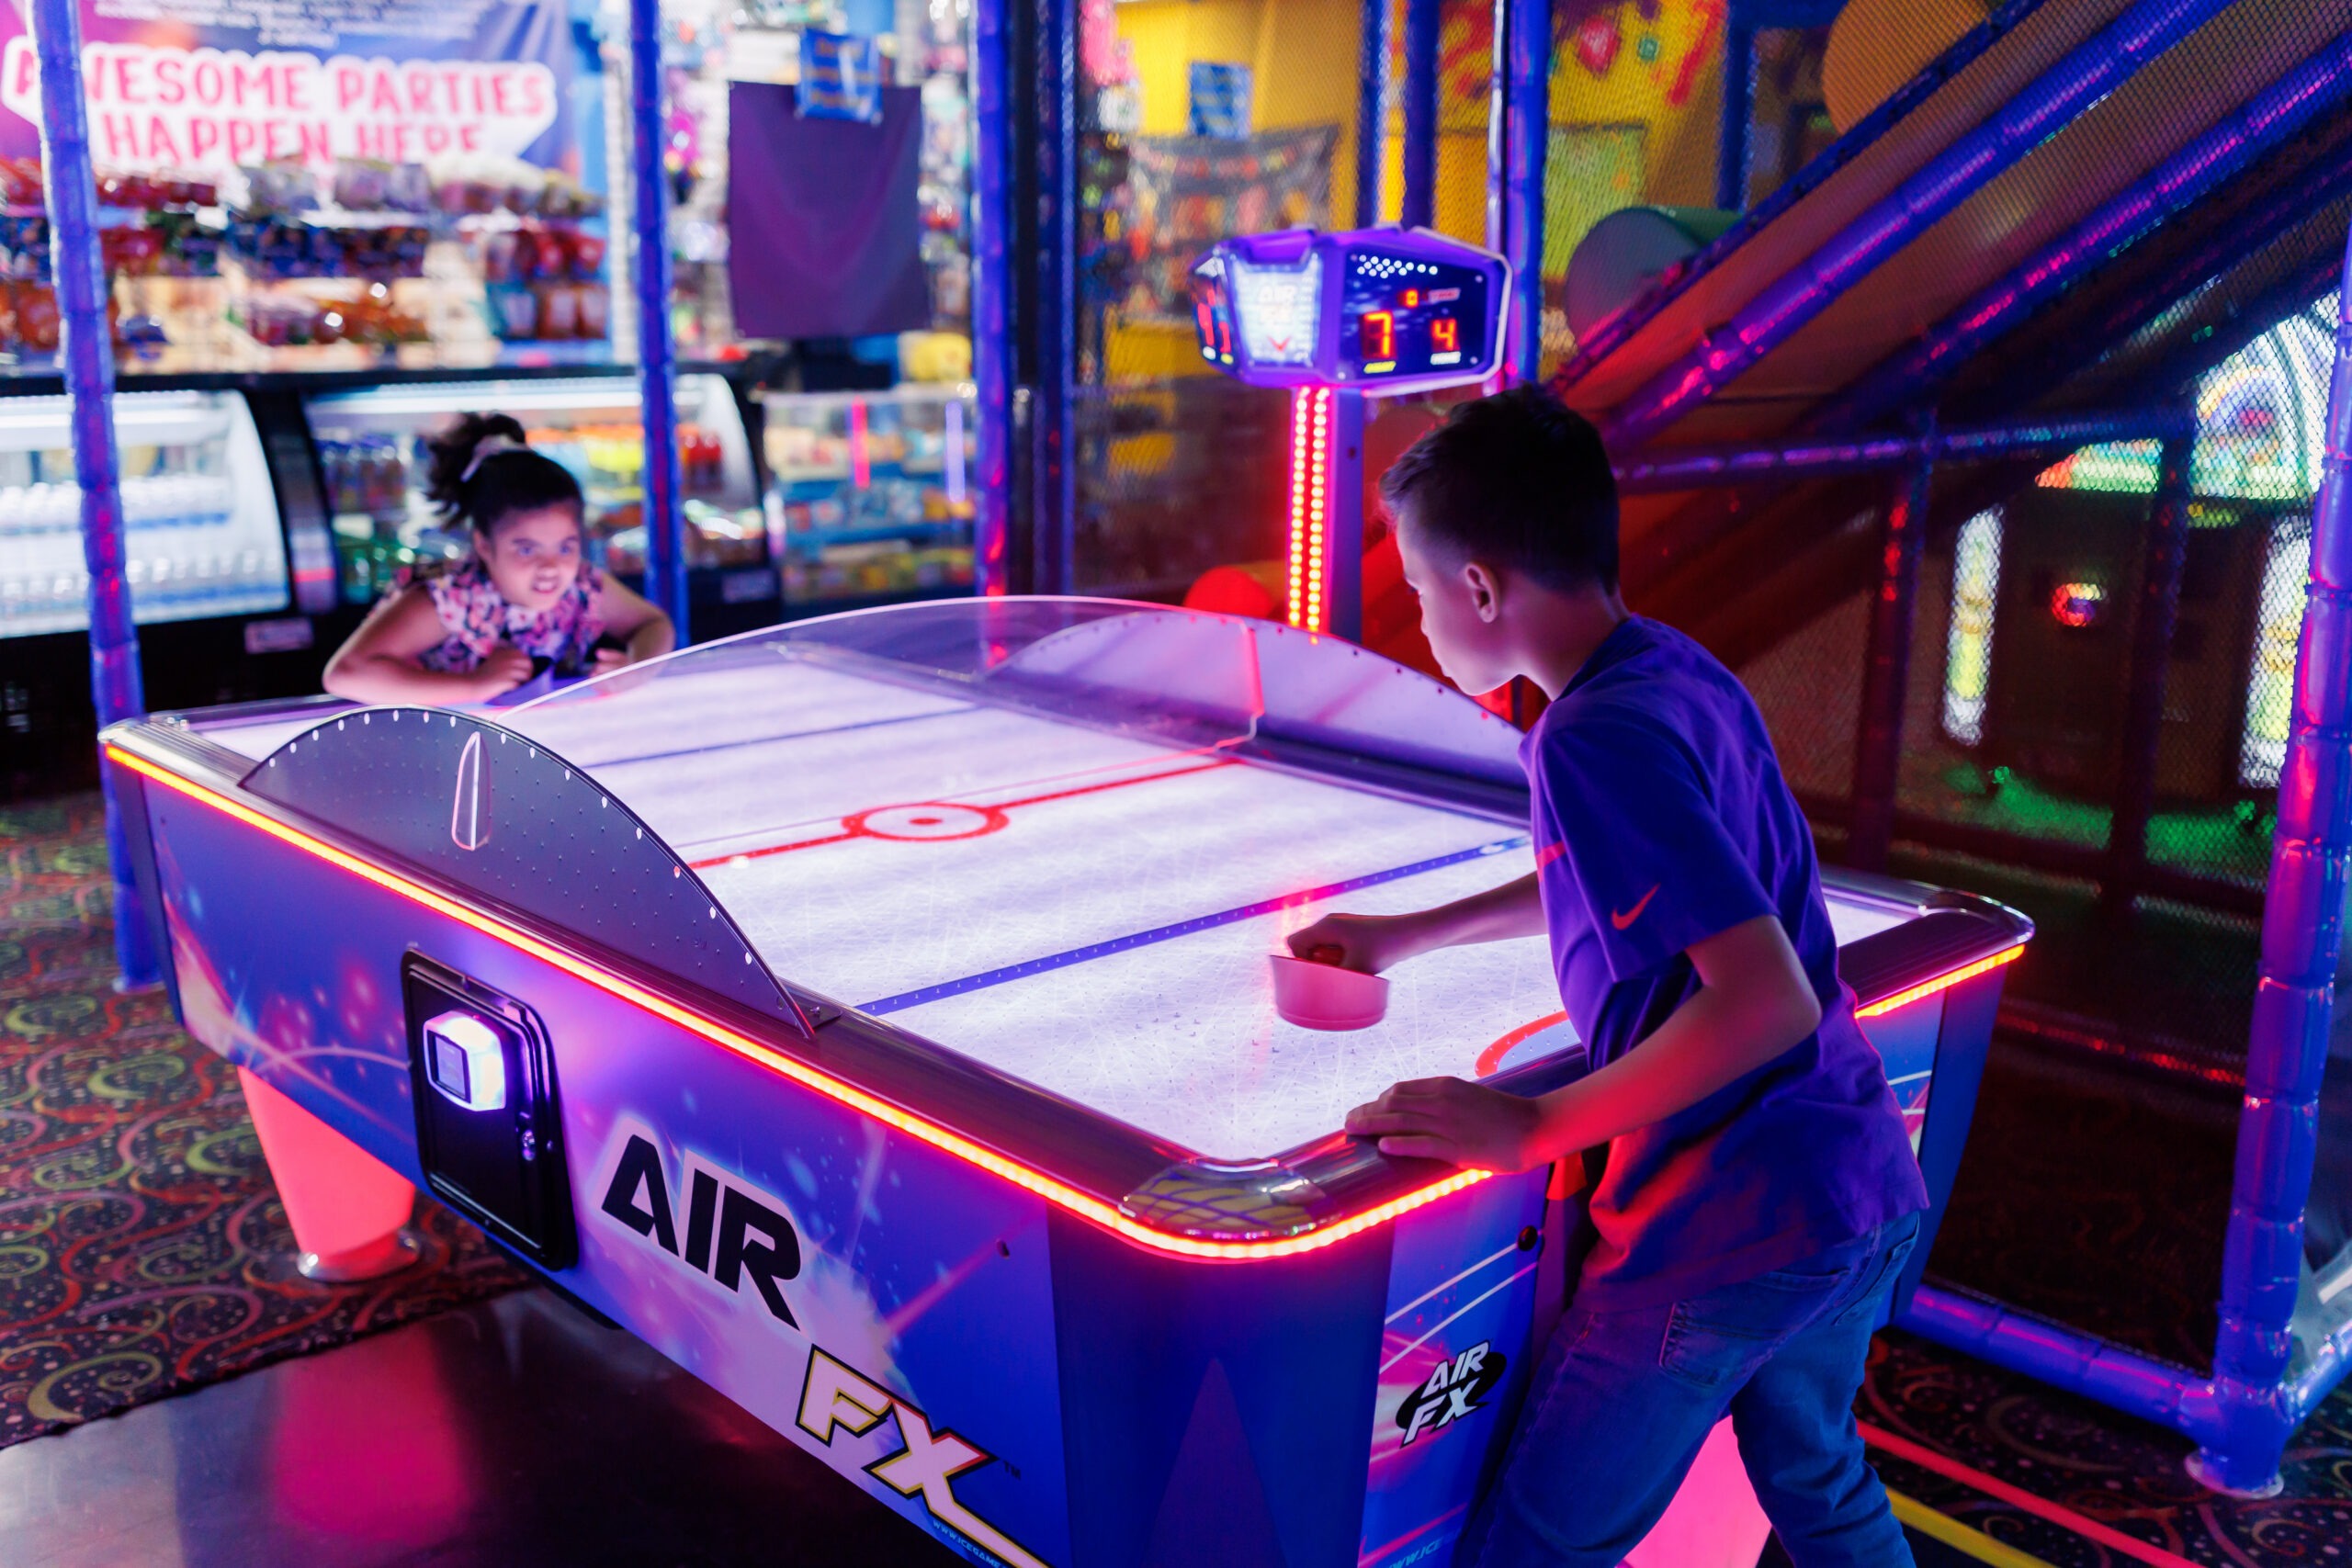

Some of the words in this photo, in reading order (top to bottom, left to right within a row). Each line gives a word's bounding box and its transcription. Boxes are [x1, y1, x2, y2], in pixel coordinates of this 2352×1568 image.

[335, 68, 546, 117] PARTIES
[102, 112, 332, 166] HAPPEN
[1363, 310, 1393, 357] 7
[1432, 319, 1457, 351] 4
[602, 1134, 801, 1332] AIR
[1419, 1340, 1489, 1400] AIR
[1400, 1376, 1481, 1448] FX
[796, 1344, 1057, 1568] FX
[933, 1518, 1010, 1568] WWW.ICEGAME
